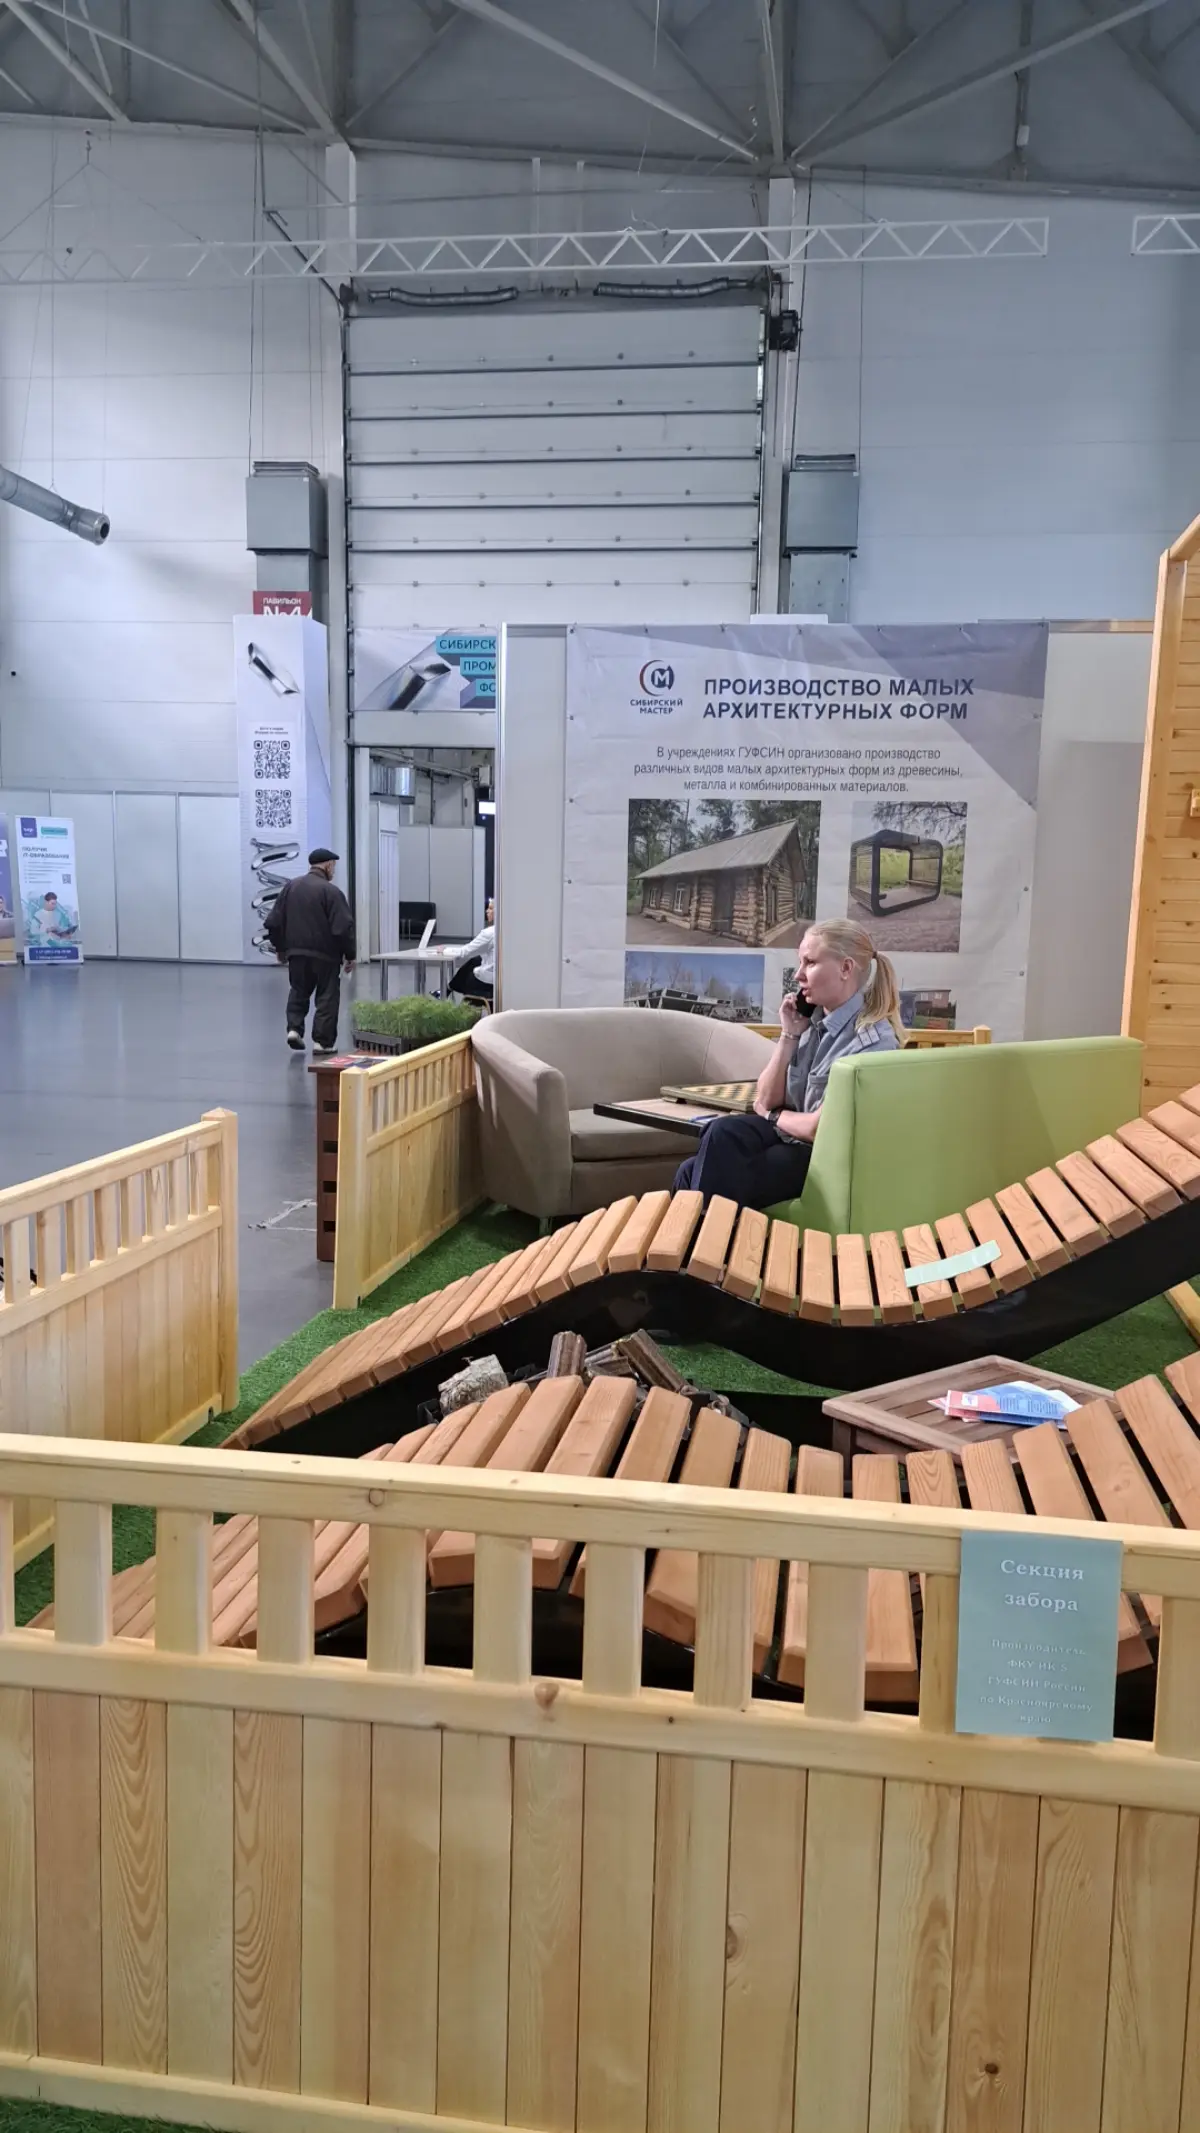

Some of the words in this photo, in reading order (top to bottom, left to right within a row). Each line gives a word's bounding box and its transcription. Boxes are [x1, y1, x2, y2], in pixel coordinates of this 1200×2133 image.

[263, 597, 302, 605] ПАВИЛЬОН
[439, 639, 496, 650] СИБИРСК
[704, 679, 881, 698] ПРОИЗВОДСТВО
[889, 678, 975, 696] МАЛЫХ
[630, 698, 683, 707] СИБИРСКИЙ
[639, 707, 673, 715] МАСТЕР
[703, 702, 892, 719] АРХИТЕКТУРНЫХ
[900, 702, 968, 719] ФОРМ
[656, 746, 664, 758] В
[667, 747, 734, 760] учреждениях
[738, 747, 785, 759] ГУФСИН
[788, 749, 861, 761] организовано
[865, 749, 941, 761] производство
[634, 763, 690, 776] различных
[694, 763, 724, 776] видов
[727, 764, 762, 775] малых
[765, 765, 845, 778] архитектурных
[848, 764, 880, 777] форм
[883, 766, 895, 776] из
[898, 765, 963, 778] древесины,
[684, 780, 726, 791] металла
[730, 781, 737, 790] и
[739, 779, 836, 793] комбинированных
[840, 781, 909, 794] материалов.
[1000, 1559, 1085, 1580] Секция
[1004, 1592, 1078, 1613] забора
[1007, 1659, 1036, 1669] ФКУ
[988, 1676, 1039, 1688] ГУФСИН
[1044, 1680, 1086, 1693] России
[980, 1696, 994, 1704] по
[998, 1695, 1093, 1712] Красноярскому
